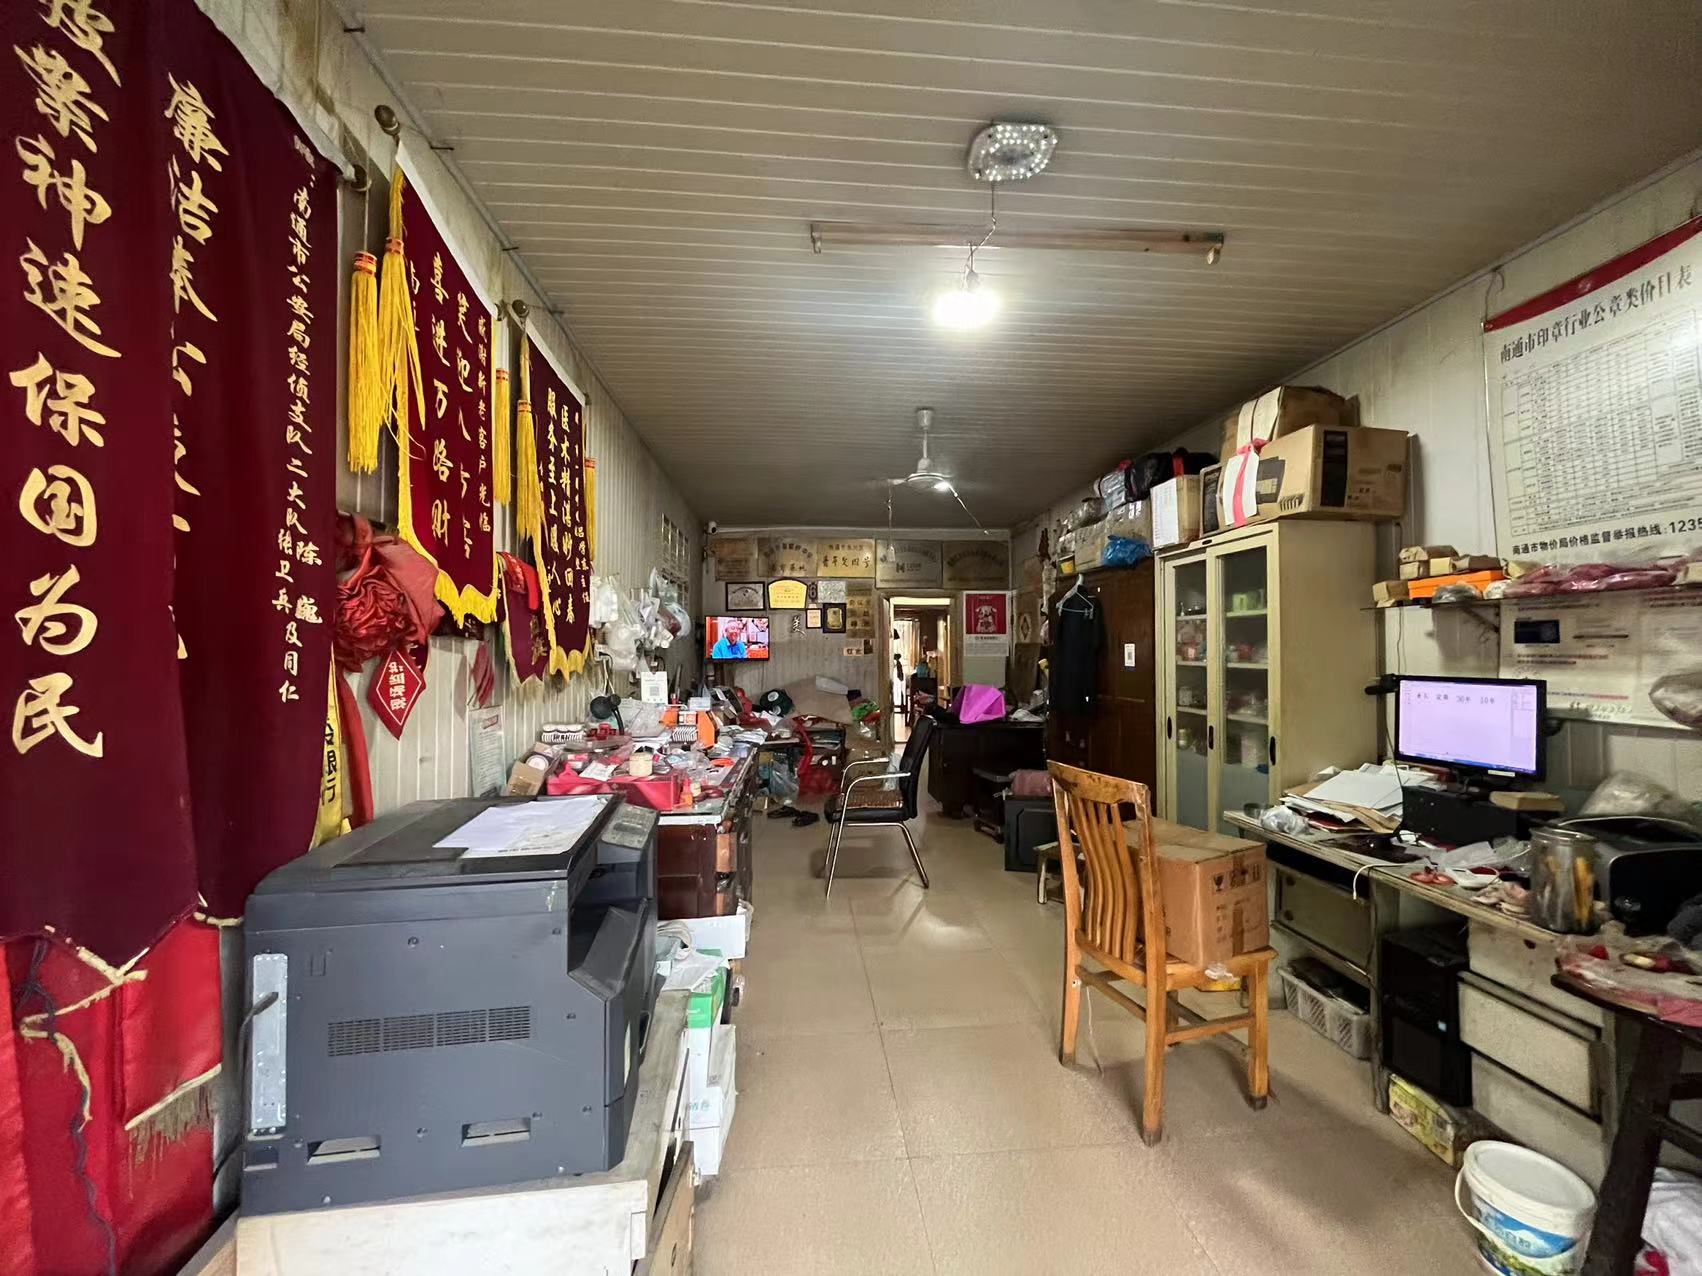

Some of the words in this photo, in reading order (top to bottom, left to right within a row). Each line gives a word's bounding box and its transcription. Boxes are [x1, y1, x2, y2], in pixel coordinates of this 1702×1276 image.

[1500, 264, 1693, 365] 南通市印章行业公章类价目表
[278, 621, 303, 703] 及同仁
